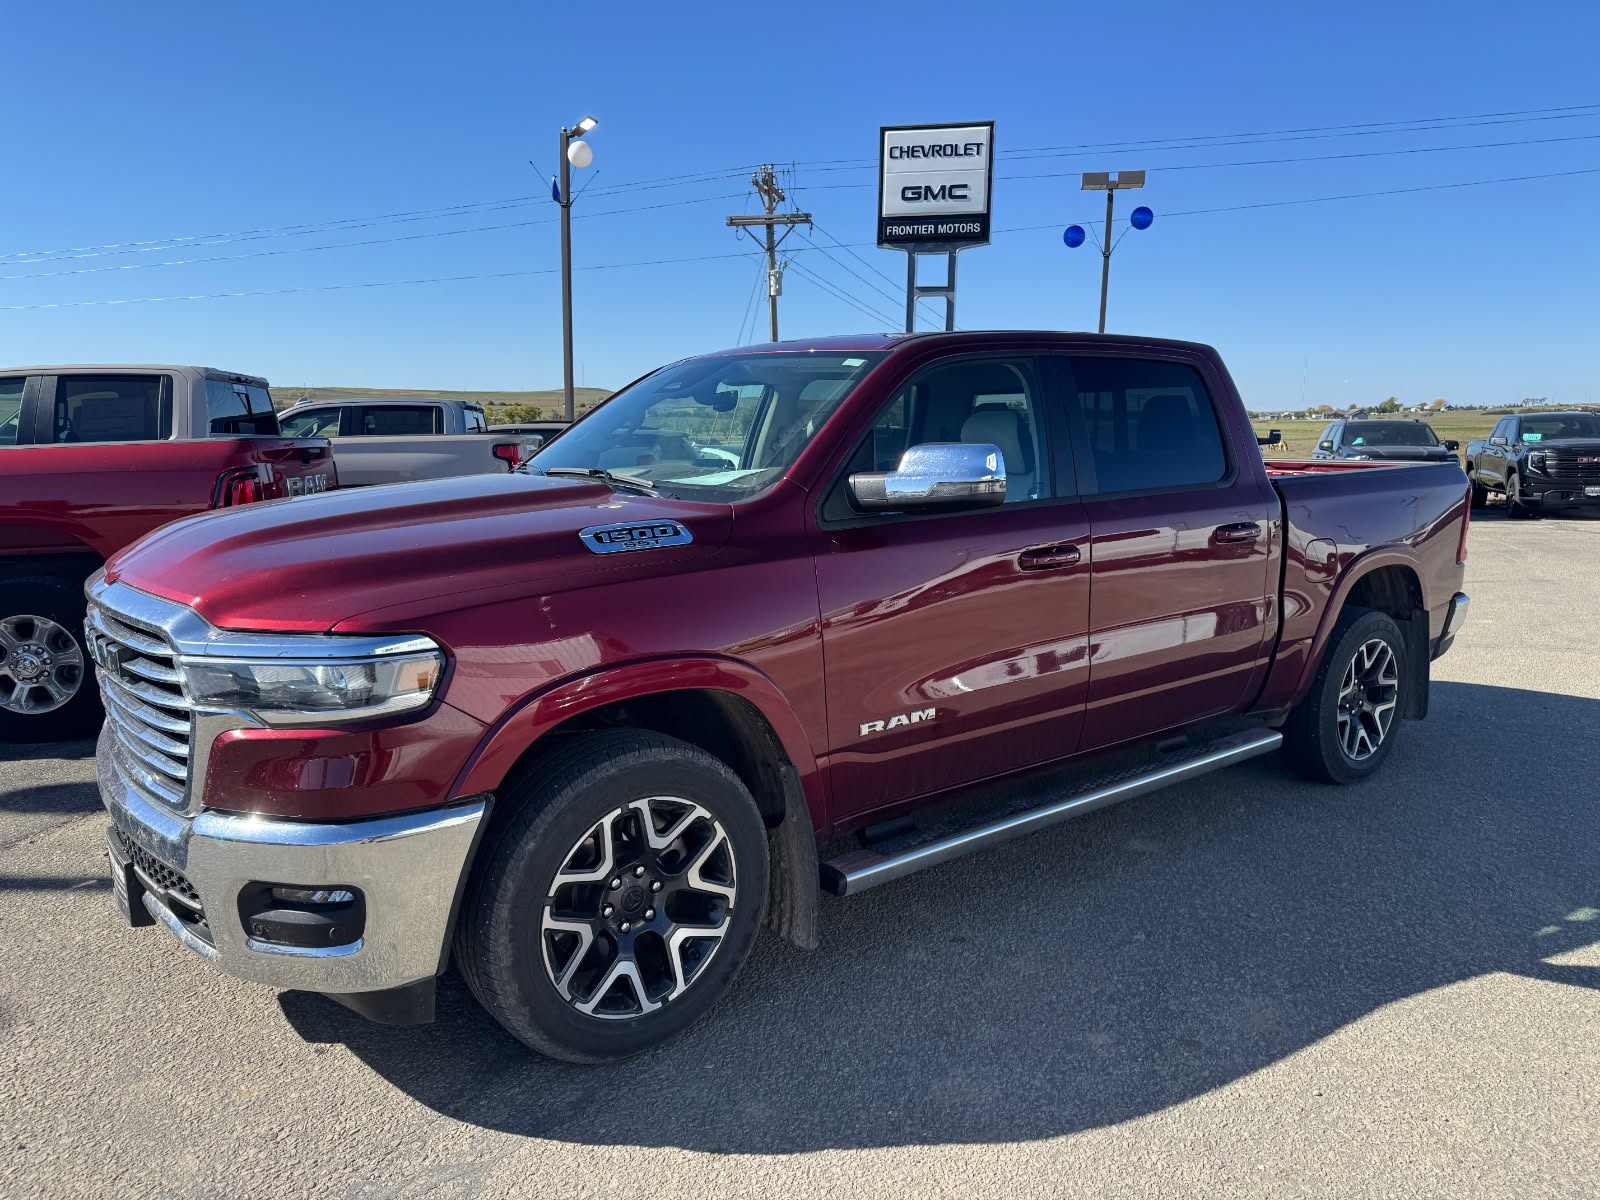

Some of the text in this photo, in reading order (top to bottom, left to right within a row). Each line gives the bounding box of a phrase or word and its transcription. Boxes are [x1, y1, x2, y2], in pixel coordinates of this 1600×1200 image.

[889, 142, 983, 159] CHEVROLET
[901, 184, 968, 201] GMC
[886, 223, 981, 236] FRONTIER MOTORS
[286, 473, 327, 498] RAM
[599, 525, 674, 543] 1500
[623, 539, 663, 549] SST
[859, 707, 936, 737] RAM
